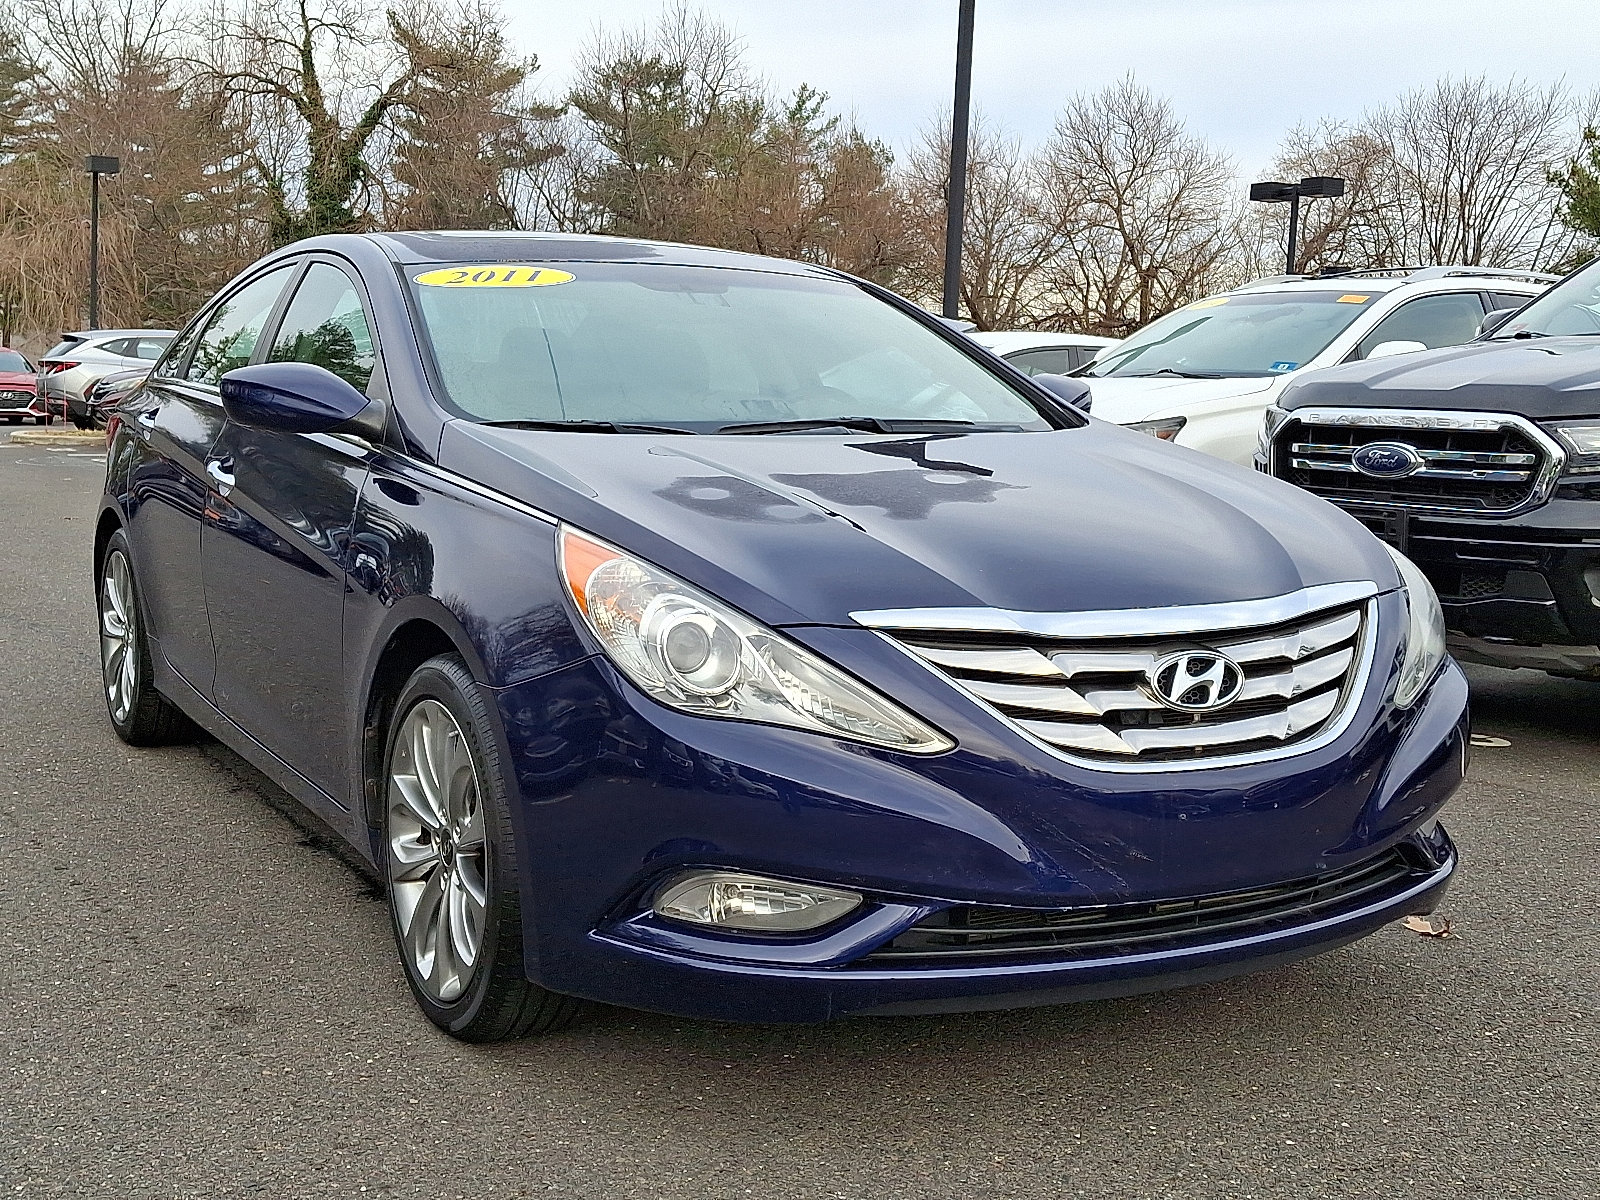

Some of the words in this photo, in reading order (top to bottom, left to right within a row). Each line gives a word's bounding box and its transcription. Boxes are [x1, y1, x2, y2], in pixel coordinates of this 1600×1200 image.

[444, 269, 542, 284] 2011
[1308, 413, 1489, 428] RANGER
[1364, 449, 1399, 468] Ford
